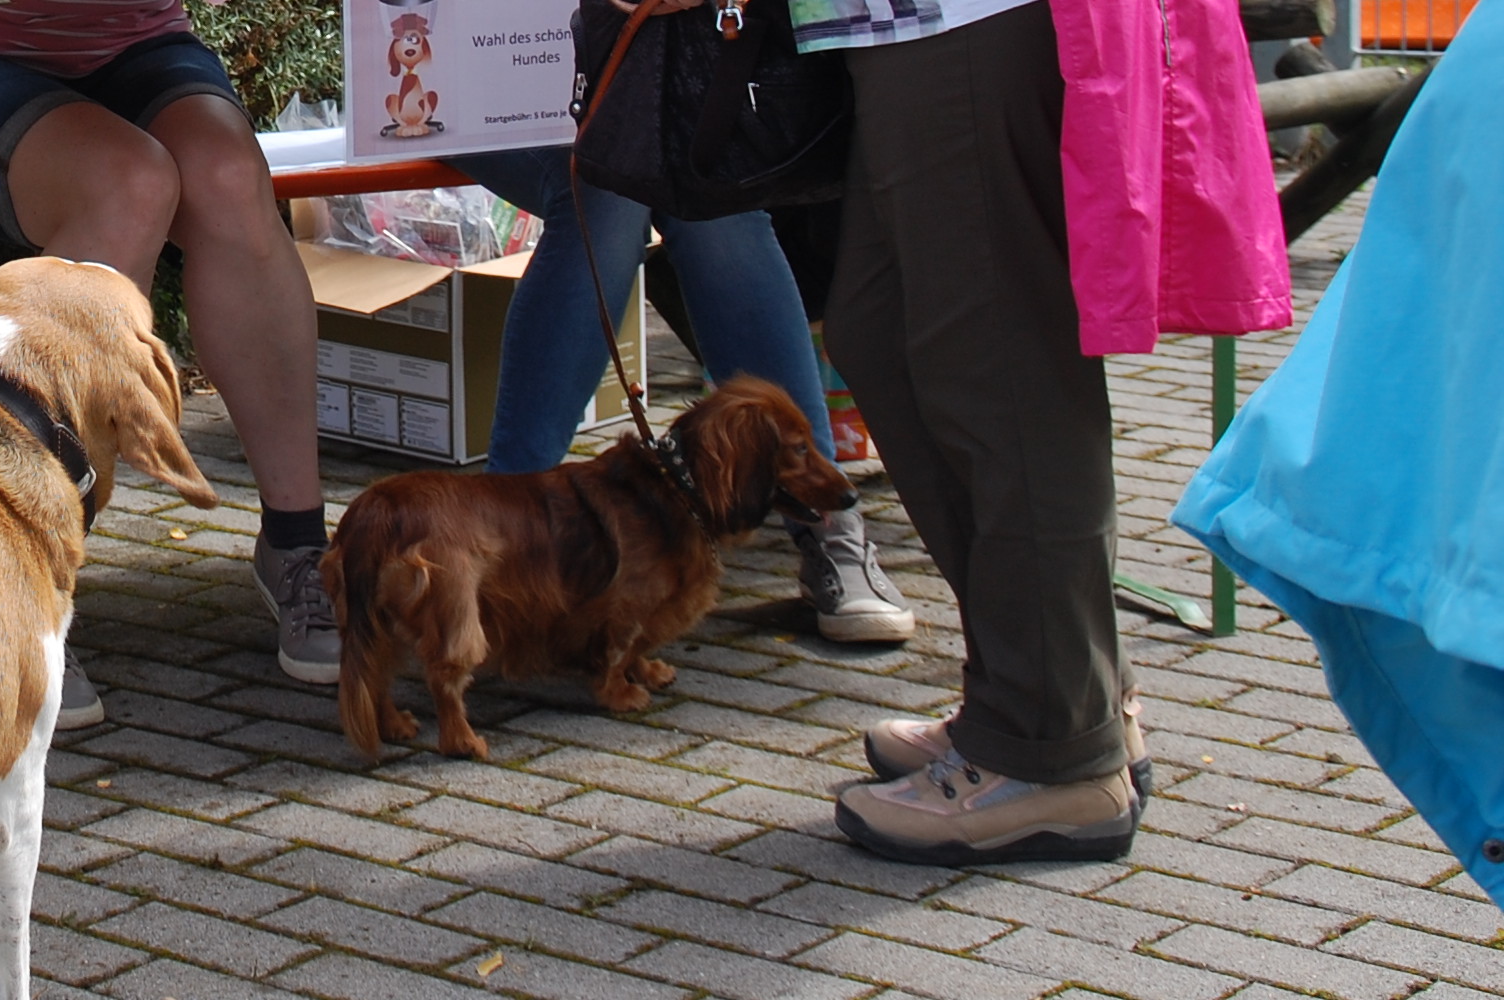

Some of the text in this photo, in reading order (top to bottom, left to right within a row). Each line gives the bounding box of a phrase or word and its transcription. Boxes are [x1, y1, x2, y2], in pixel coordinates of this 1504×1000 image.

[472, 32, 506, 48] Wahl
[509, 31, 531, 45] des
[512, 52, 561, 67] Hundes
[485, 113, 532, 124] Startgebühr:
[541, 110, 558, 119] Euro
[559, 109, 567, 119] je
